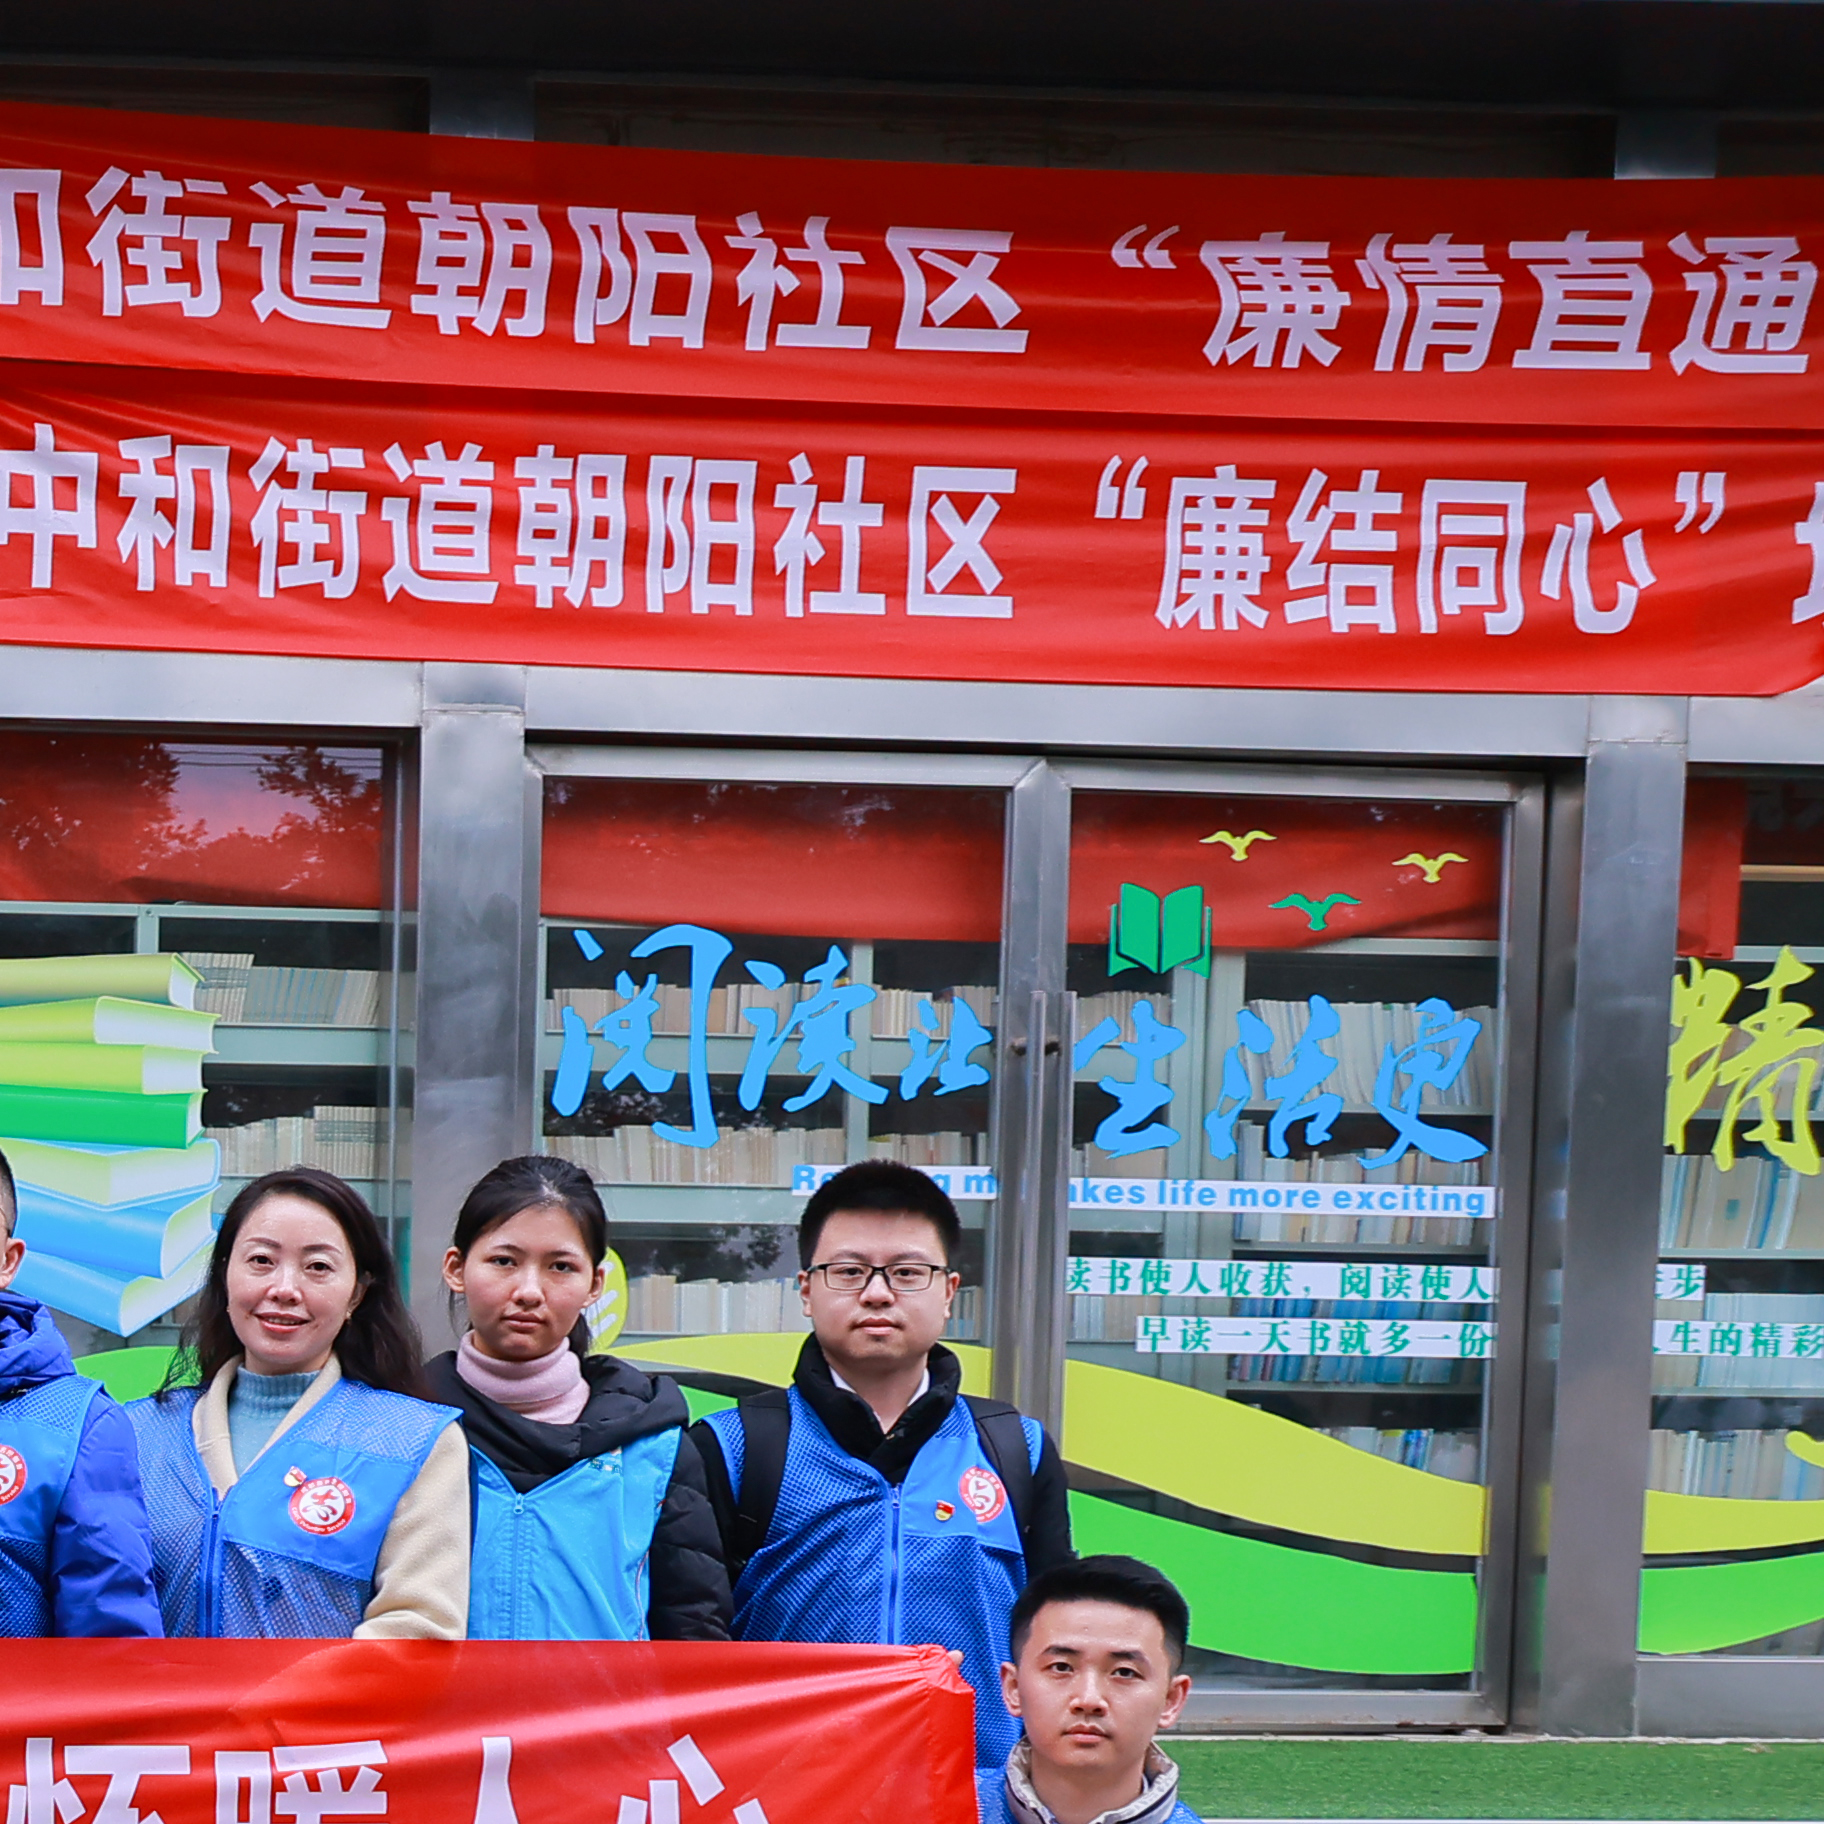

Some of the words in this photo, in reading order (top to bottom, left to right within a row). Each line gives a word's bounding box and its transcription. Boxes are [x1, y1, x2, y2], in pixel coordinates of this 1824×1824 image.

[1158, 1179, 1218, 1207] life
[1228, 1186, 1322, 1209] more
[1333, 1185, 1486, 1217] exciting
[1653, 1320, 1823, 1358] 生的精彩
